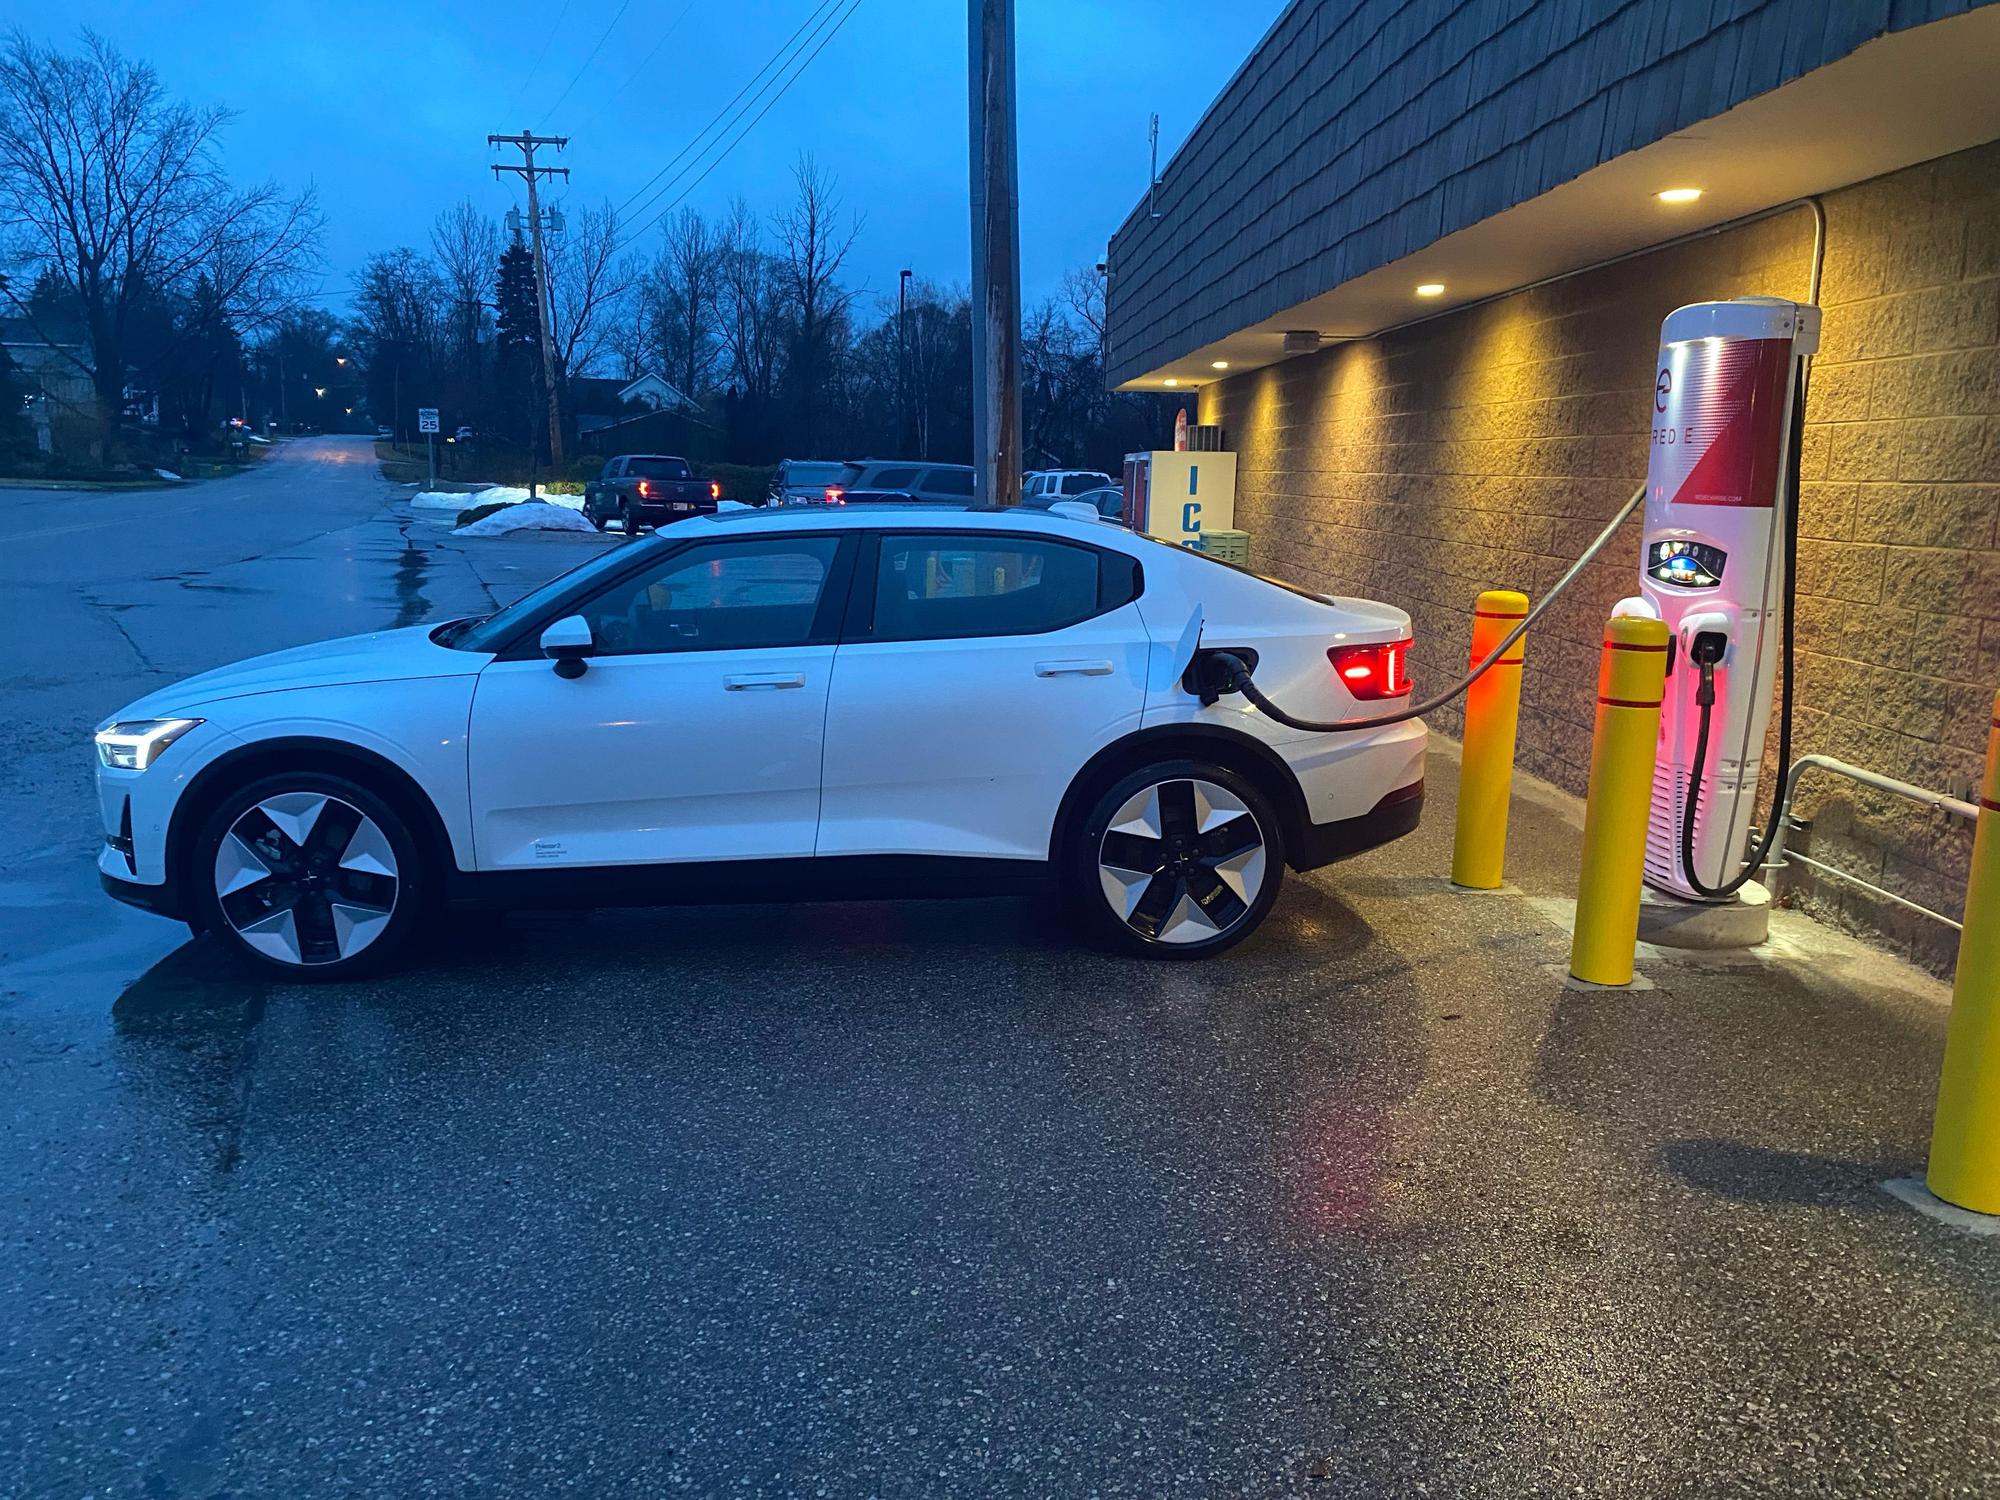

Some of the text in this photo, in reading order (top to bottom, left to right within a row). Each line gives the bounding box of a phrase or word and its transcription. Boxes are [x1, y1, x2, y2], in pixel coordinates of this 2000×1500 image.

[421, 420, 438, 430] 25
[1653, 427, 1694, 445] RED E
